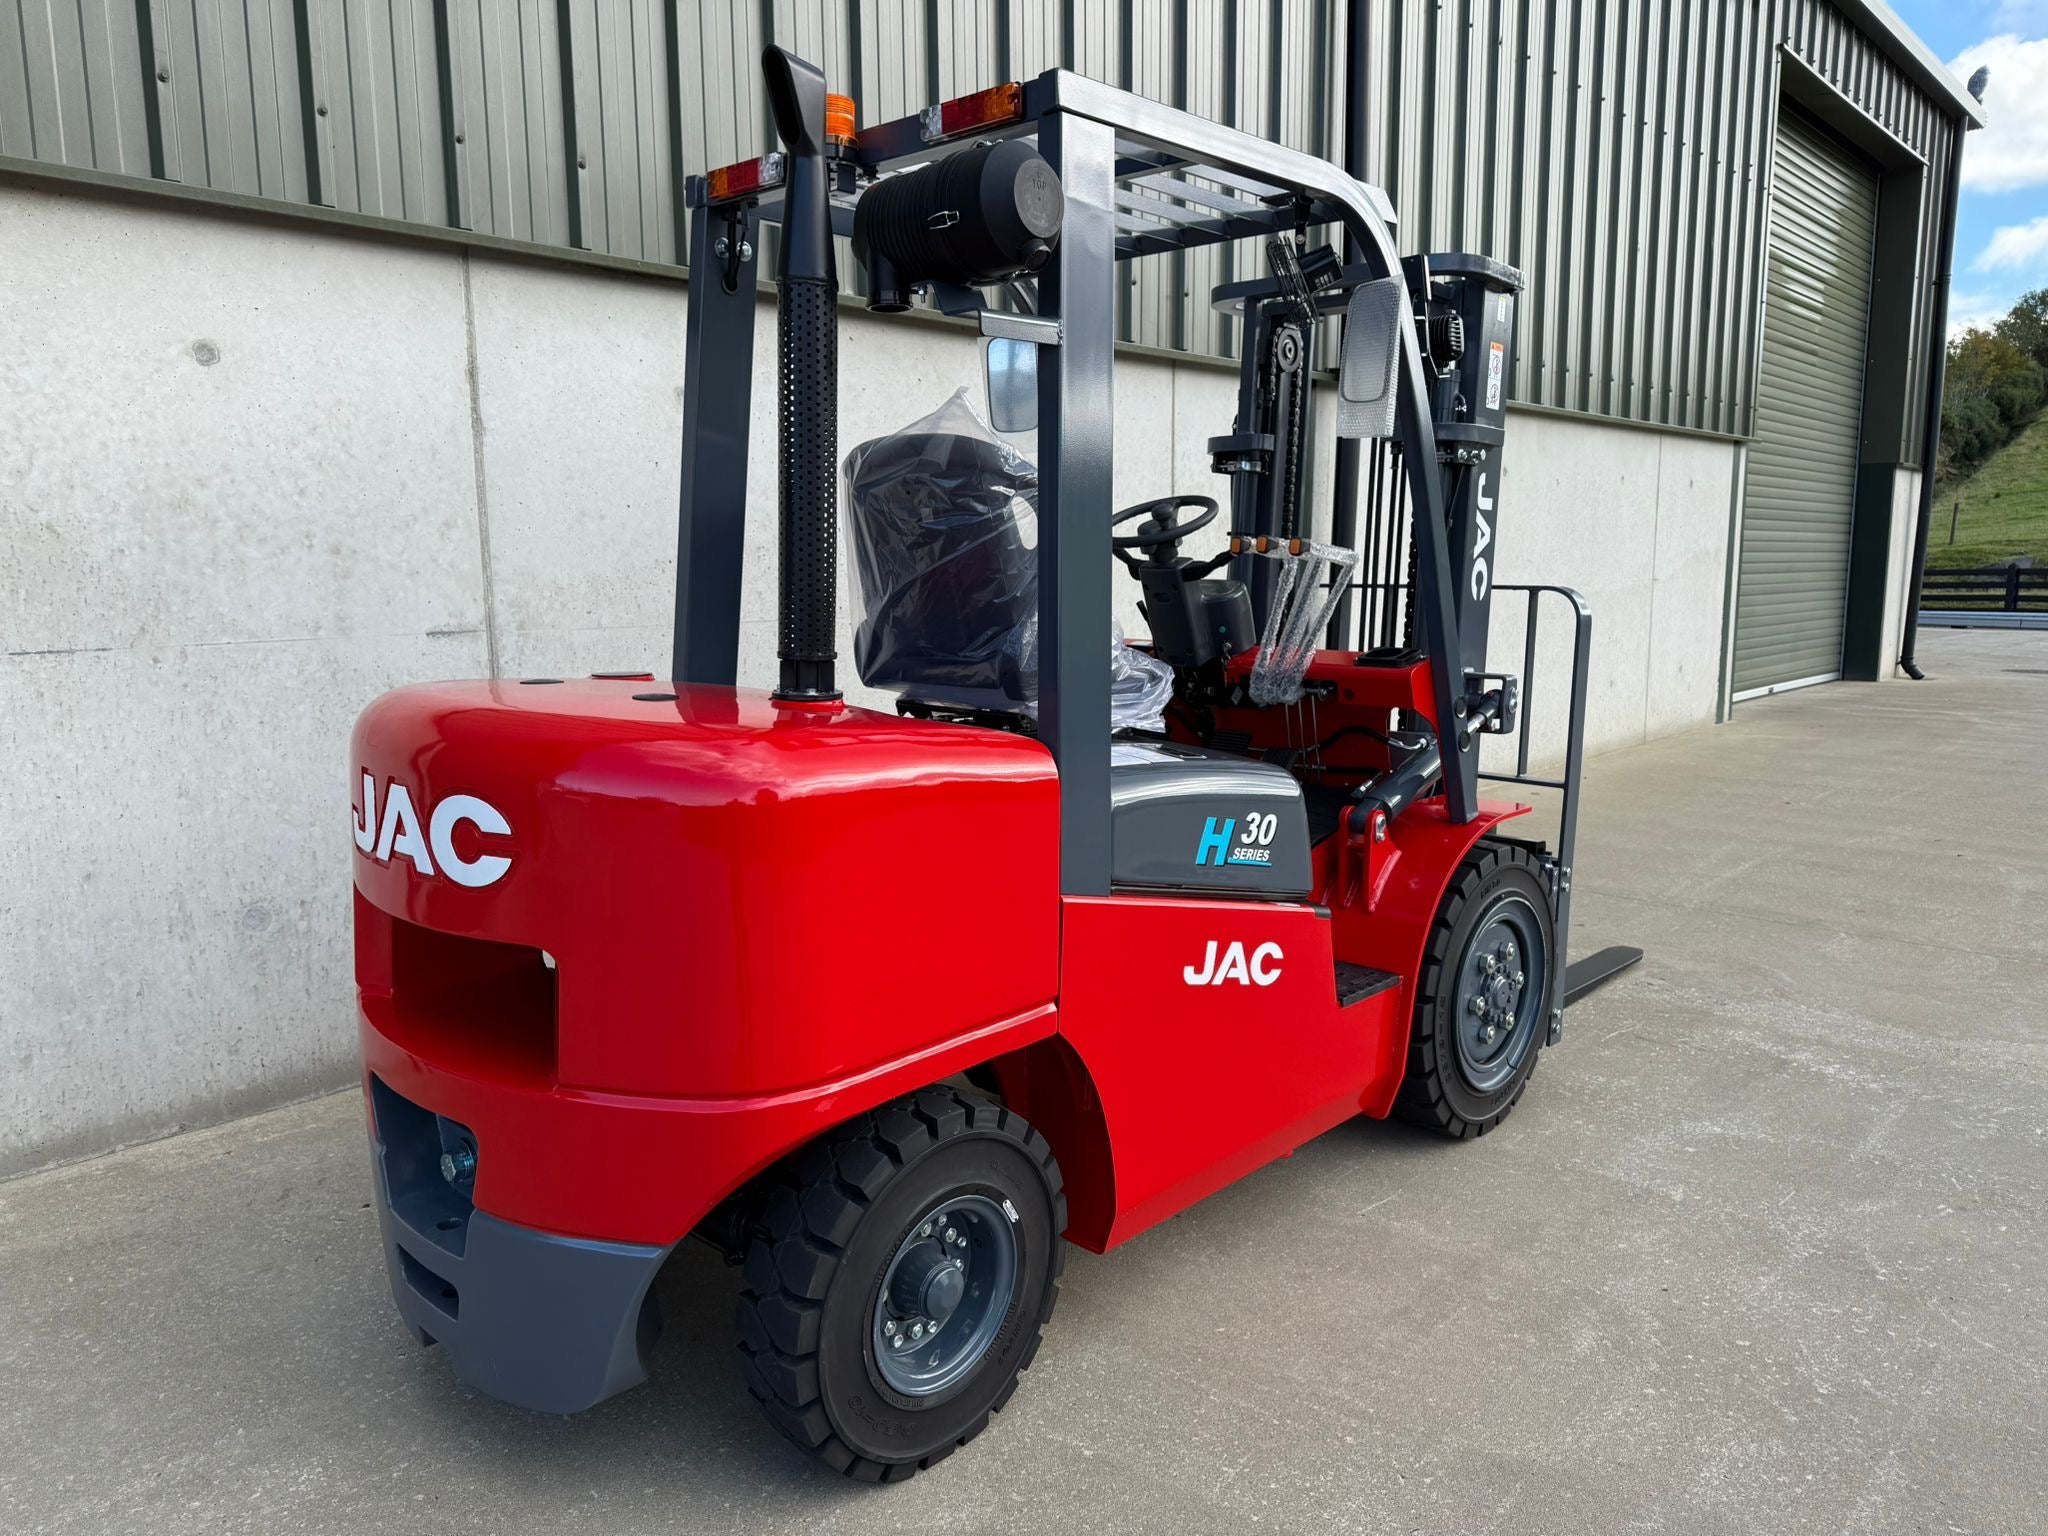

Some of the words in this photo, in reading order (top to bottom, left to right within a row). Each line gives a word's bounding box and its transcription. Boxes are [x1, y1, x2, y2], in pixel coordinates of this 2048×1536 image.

[1031, 178, 1047, 191] TOP
[1471, 472, 1493, 601] JAC
[352, 773, 512, 888] JAC
[1195, 816, 1236, 867] H
[1240, 811, 1278, 846] 30
[1232, 847, 1271, 862] SERIES
[1183, 940, 1284, 986] JAC
